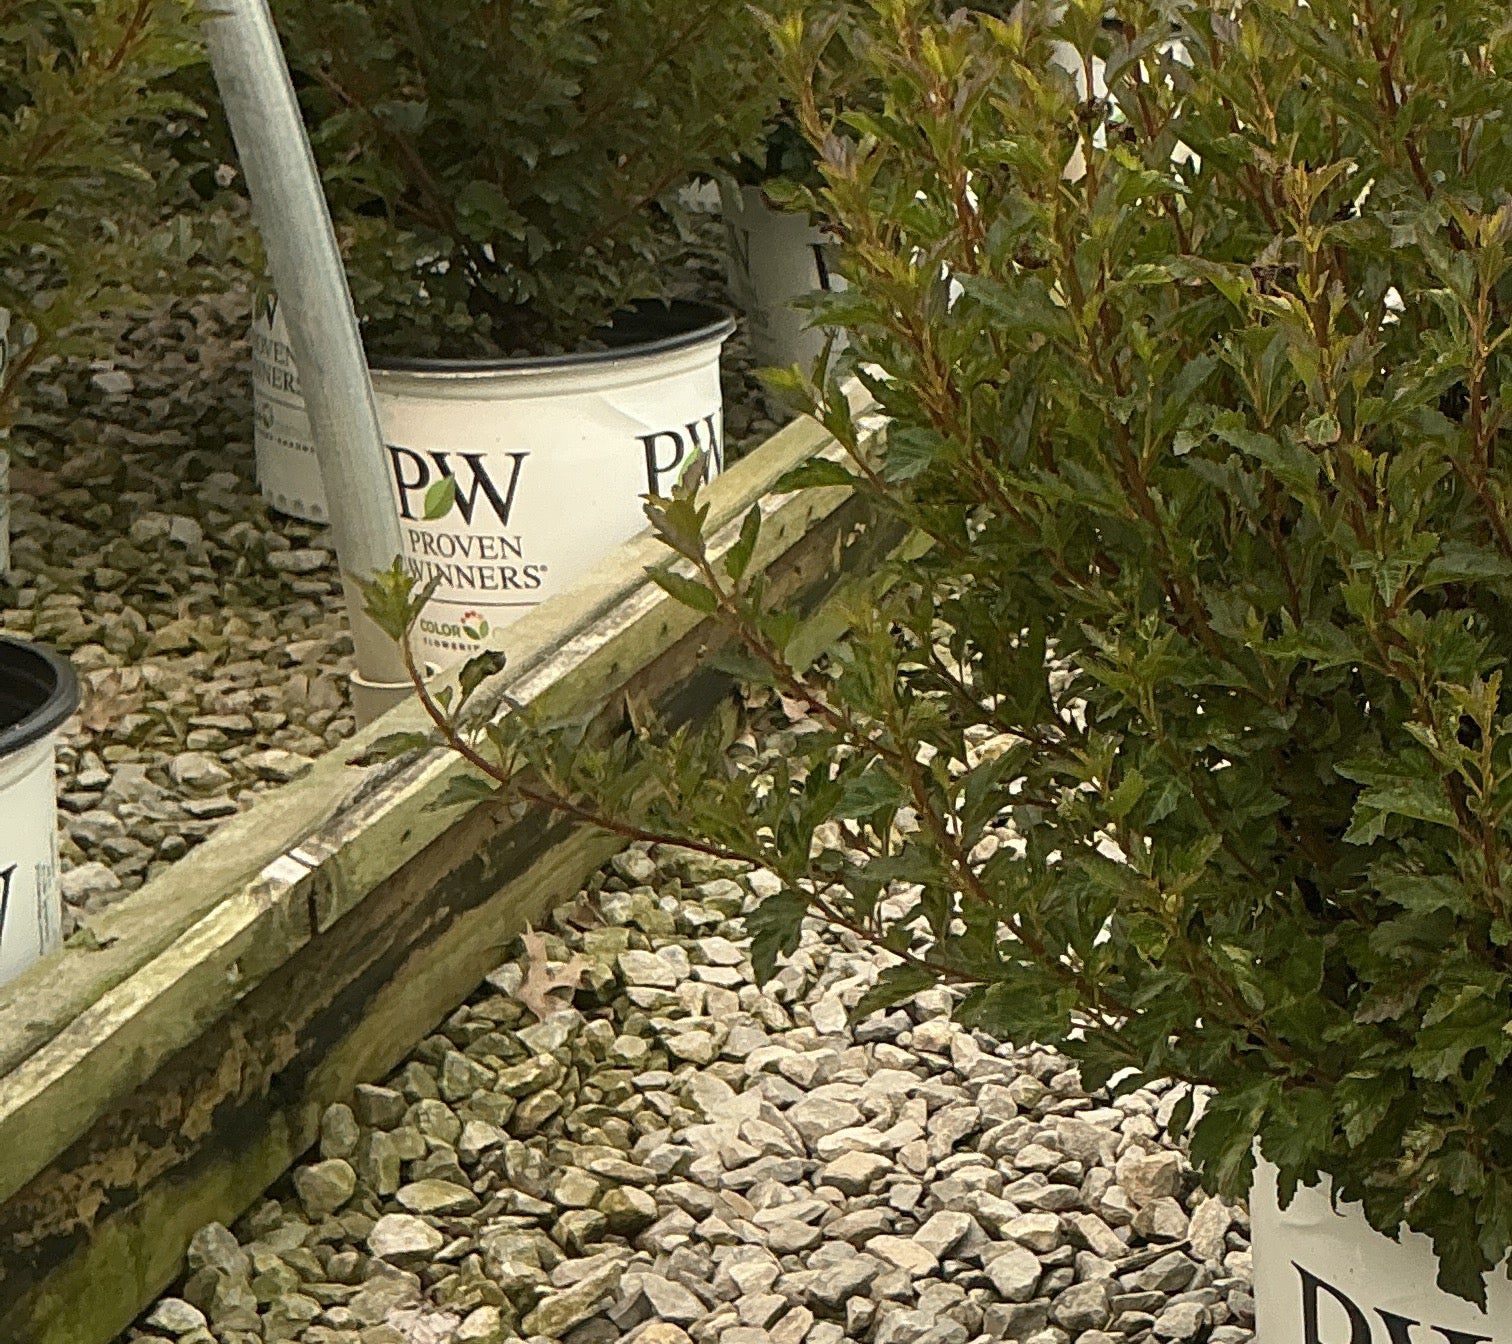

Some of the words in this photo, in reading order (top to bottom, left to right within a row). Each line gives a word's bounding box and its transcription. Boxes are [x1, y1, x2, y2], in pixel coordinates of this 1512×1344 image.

[384, 443, 531, 527] PW
[408, 528, 523, 561] PROVEN
[420, 618, 461, 638] COLOR
